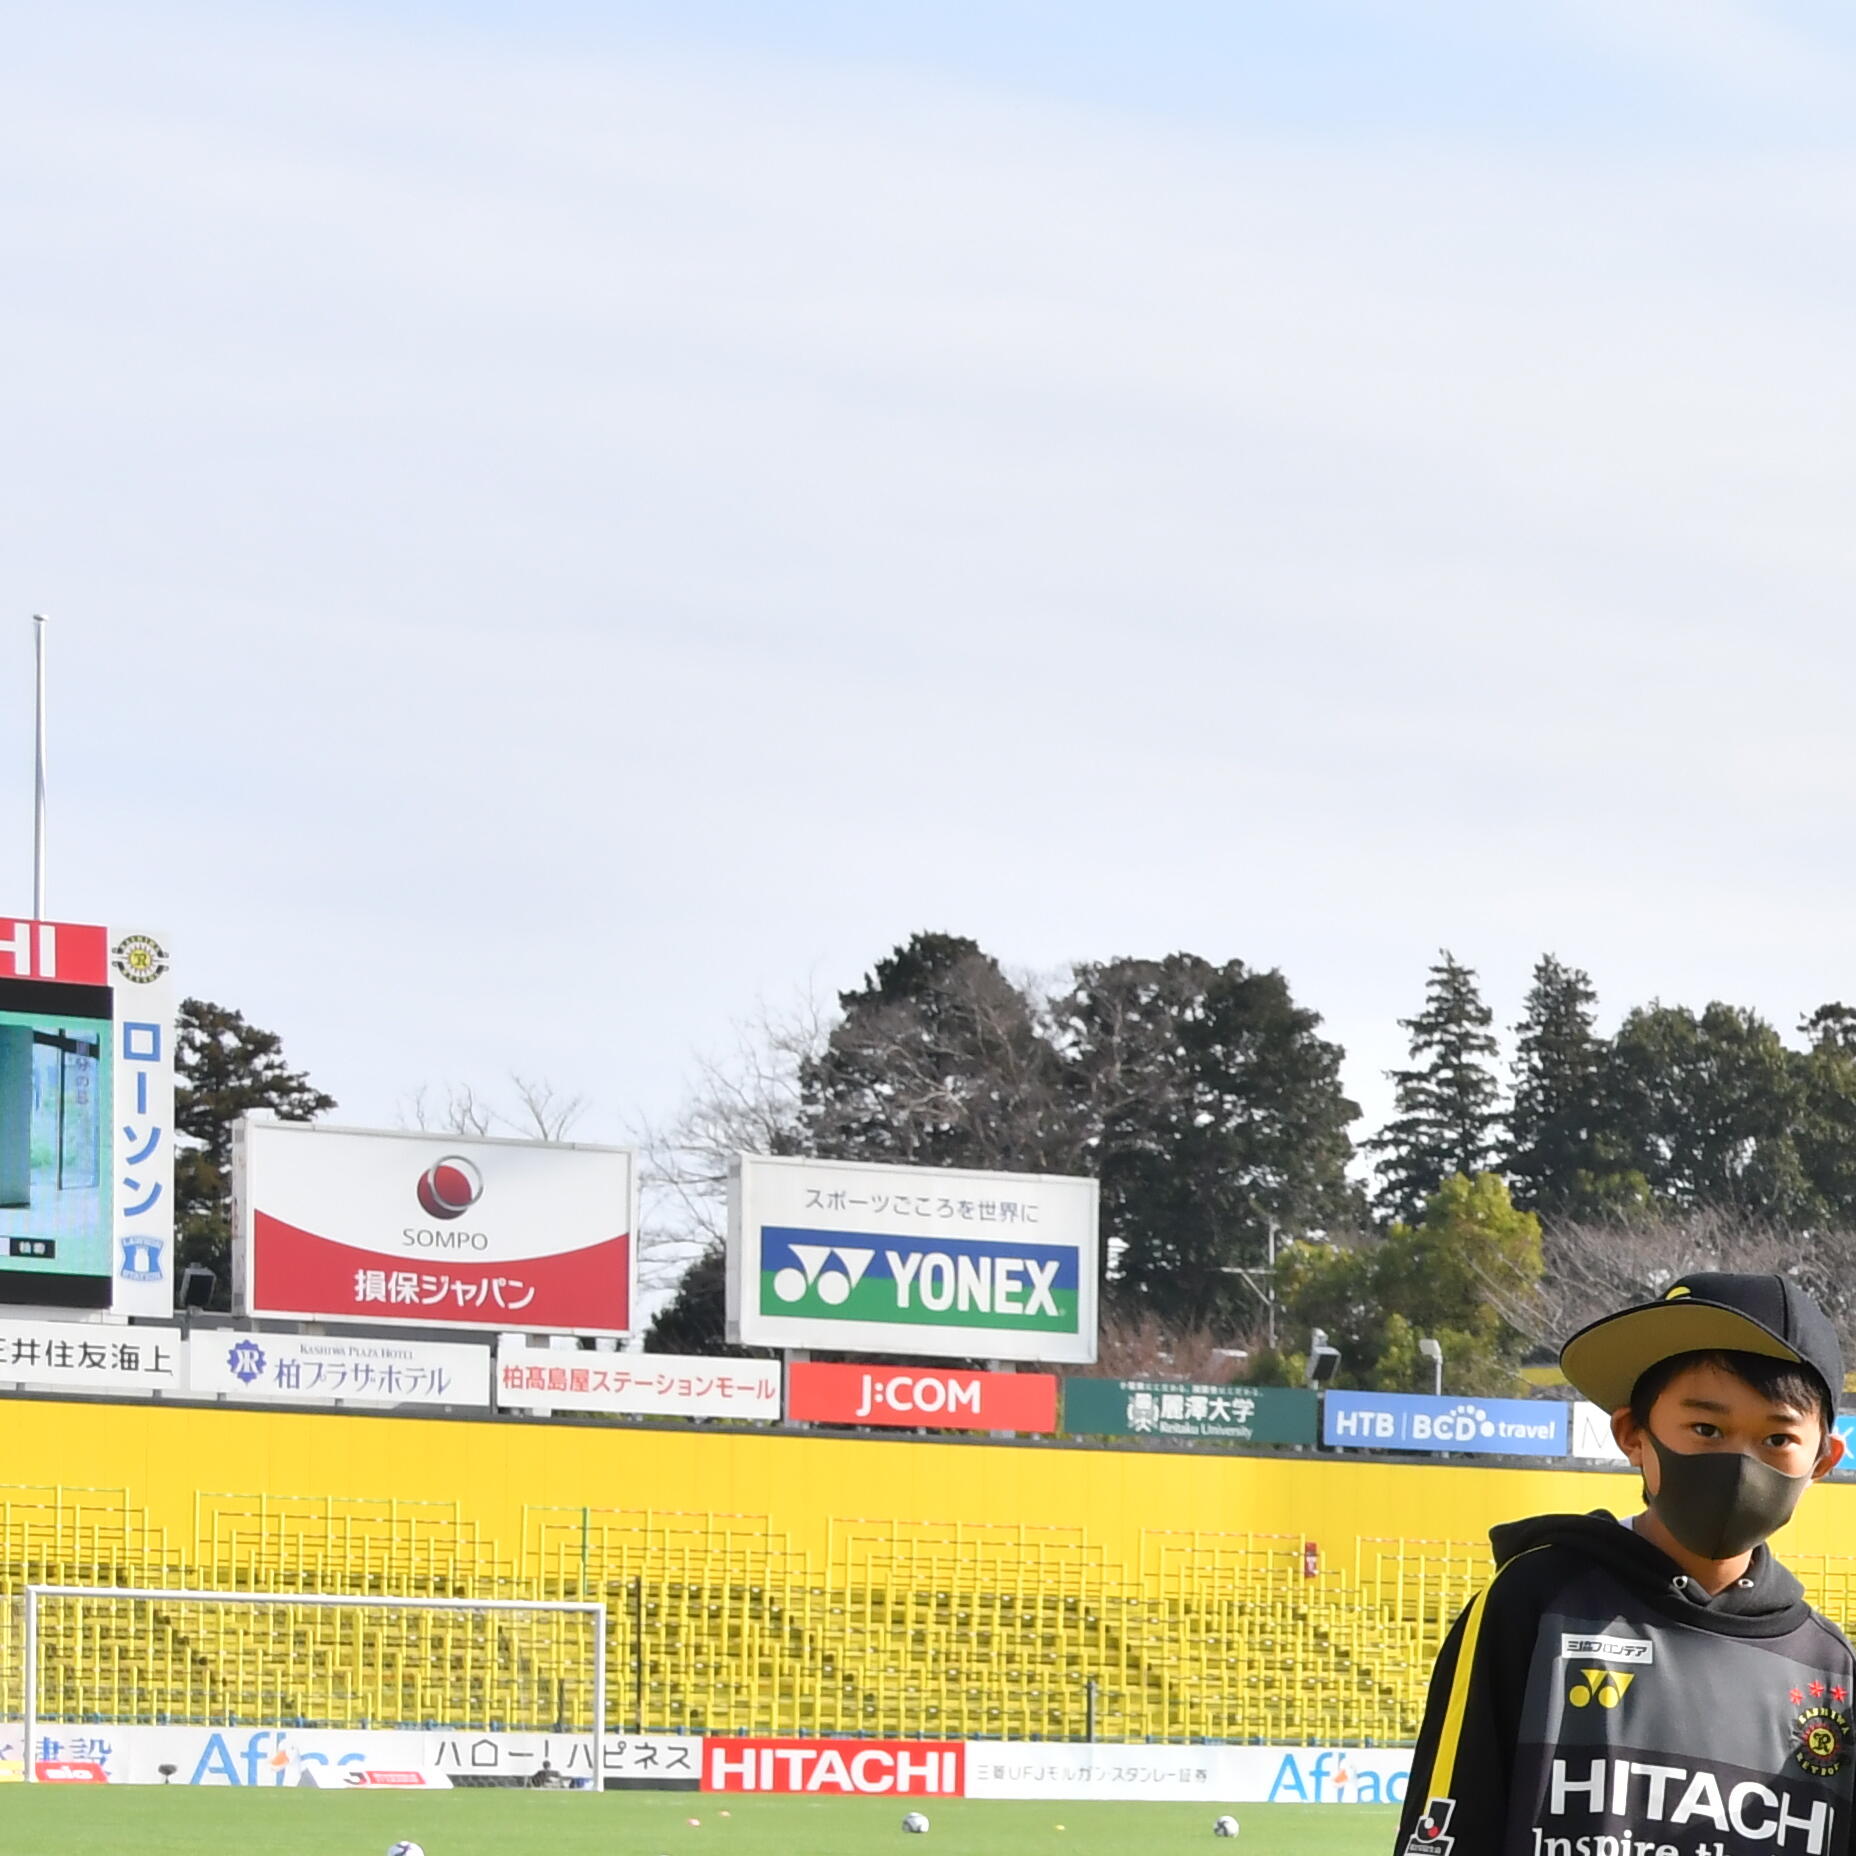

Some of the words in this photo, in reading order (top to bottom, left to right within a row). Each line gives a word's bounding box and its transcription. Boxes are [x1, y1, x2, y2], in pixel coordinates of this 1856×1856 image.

[123, 1021, 162, 1217] ローソン
[805, 1189, 1039, 1224] スポーツごころを世界に
[402, 1228, 489, 1251] SOMPO
[354, 1269, 535, 1310] 損保ジャパン
[885, 1250, 1061, 1317] YONEX
[0, 1337, 174, 1377] 井住友海上
[274, 1358, 452, 1396] 柏プラザホテル
[857, 1374, 981, 1417] J:COM
[1336, 1410, 1395, 1438] HTB
[1498, 1420, 1555, 1441] travel
[712, 1748, 956, 1793] HITACHI
